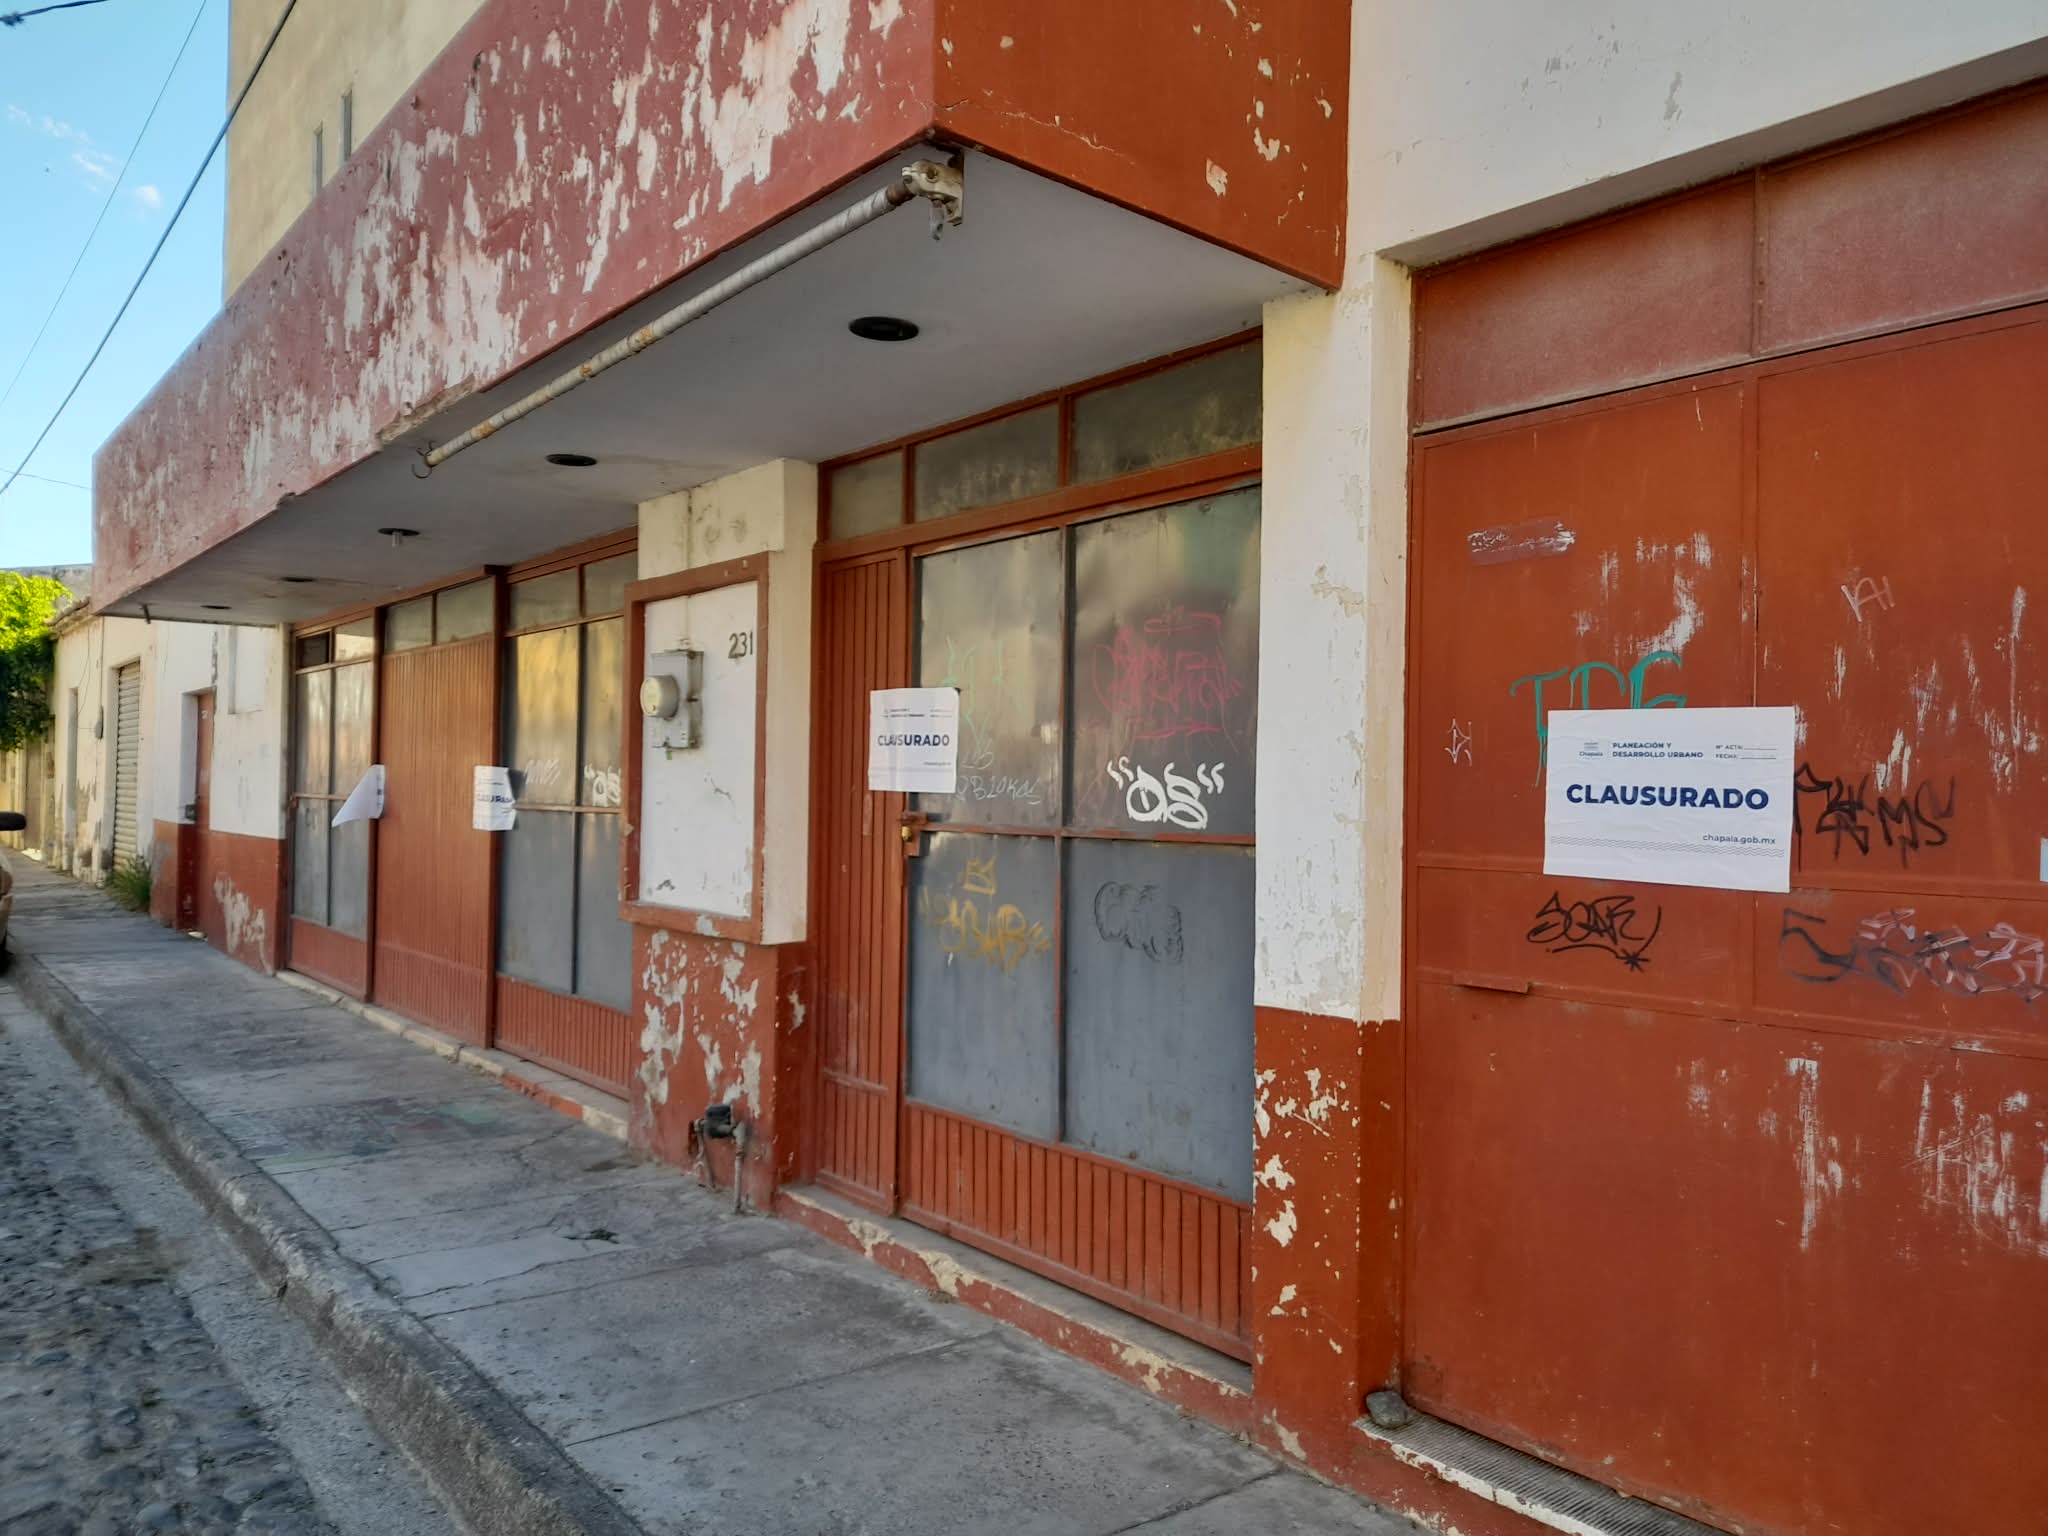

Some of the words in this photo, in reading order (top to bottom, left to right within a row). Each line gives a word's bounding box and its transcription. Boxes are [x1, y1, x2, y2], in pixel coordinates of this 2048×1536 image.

[728, 632, 754, 659] 231
[1612, 741, 1664, 749] PLANEACIÓN
[1566, 784, 1769, 810] CLAUSURADO
[1702, 834, 1776, 844] chapala.gob.mx
